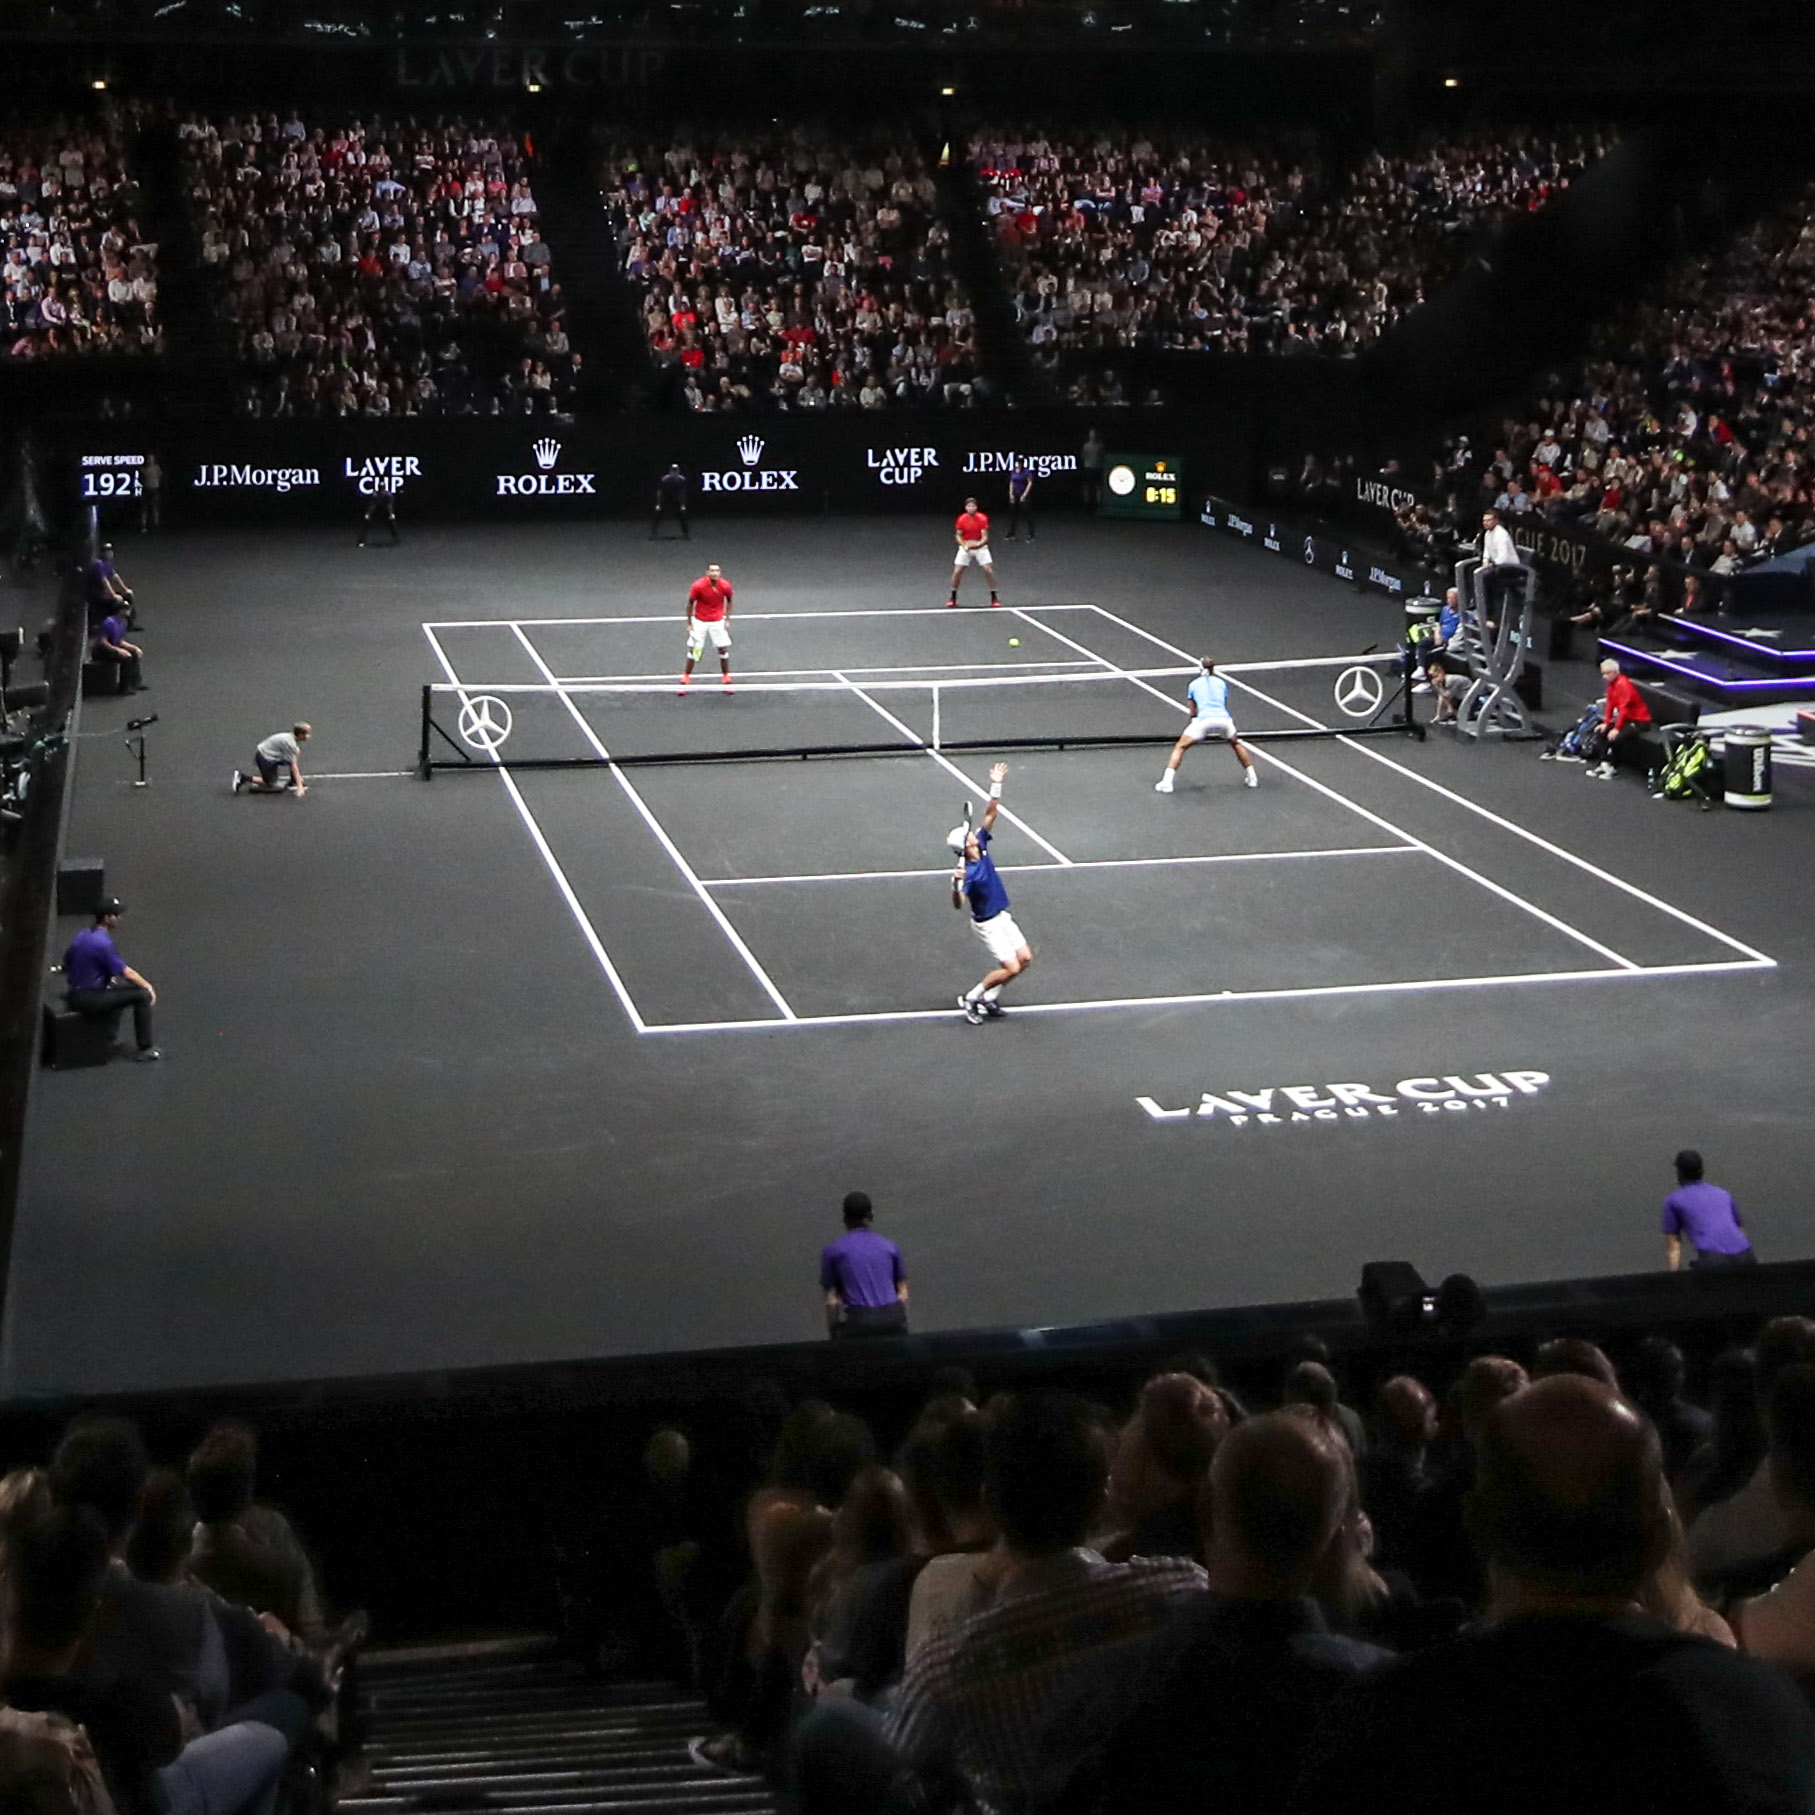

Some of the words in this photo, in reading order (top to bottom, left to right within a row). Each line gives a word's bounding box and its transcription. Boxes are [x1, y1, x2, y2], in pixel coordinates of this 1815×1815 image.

[82, 455, 113, 465] SERVE
[114, 455, 144, 465] SPEED
[345, 456, 422, 476] LAVER
[868, 448, 939, 468] LAVER
[84, 473, 131, 496] 192
[194, 464, 320, 492] J.P.Morgan
[496, 474, 596, 495] ROLEX
[702, 470, 799, 491] ROLEX
[880, 467, 922, 485] CUP
[1145, 472, 1176, 481] ROLEX
[1357, 478, 1389, 508] LAVER
[1550, 536, 1586, 567] 2017
[1135, 1083, 1397, 1120] LAVER
[1396, 1070, 1551, 1100] CUP
[1229, 1103, 1399, 1126] PRAGUE
[1418, 1096, 1510, 1113] 2017
